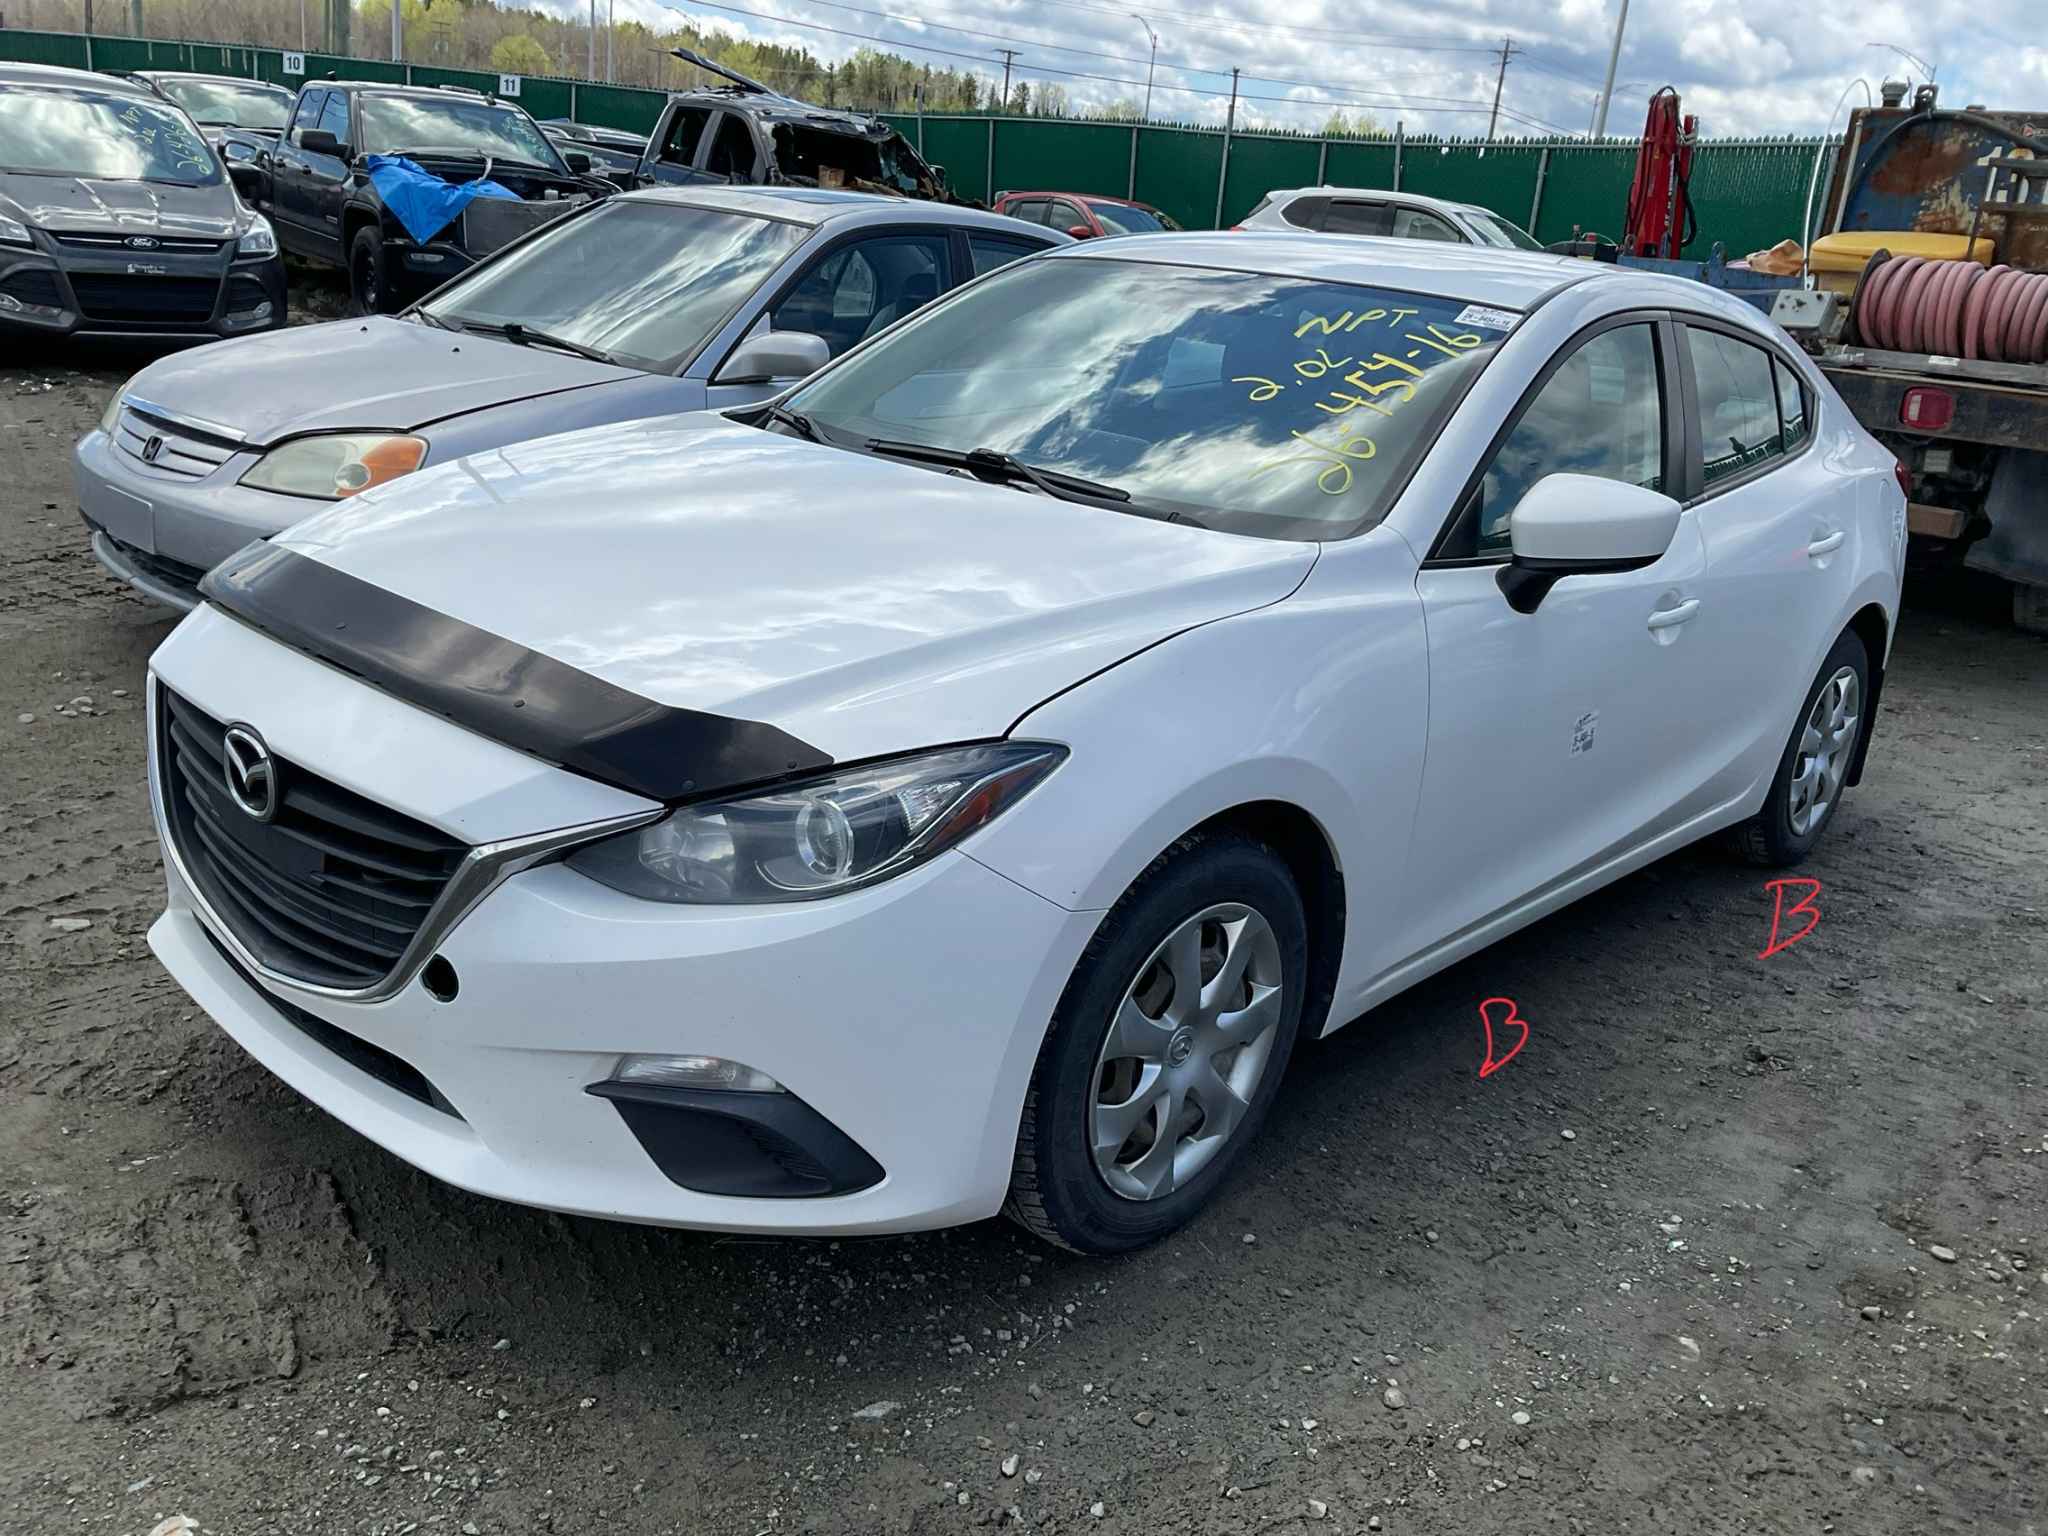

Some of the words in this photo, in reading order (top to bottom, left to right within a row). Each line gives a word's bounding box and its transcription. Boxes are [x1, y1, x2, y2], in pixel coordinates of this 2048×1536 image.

[286, 56, 301, 71] 10
[504, 79, 516, 92] 11
[1293, 308, 1419, 338] NPT
